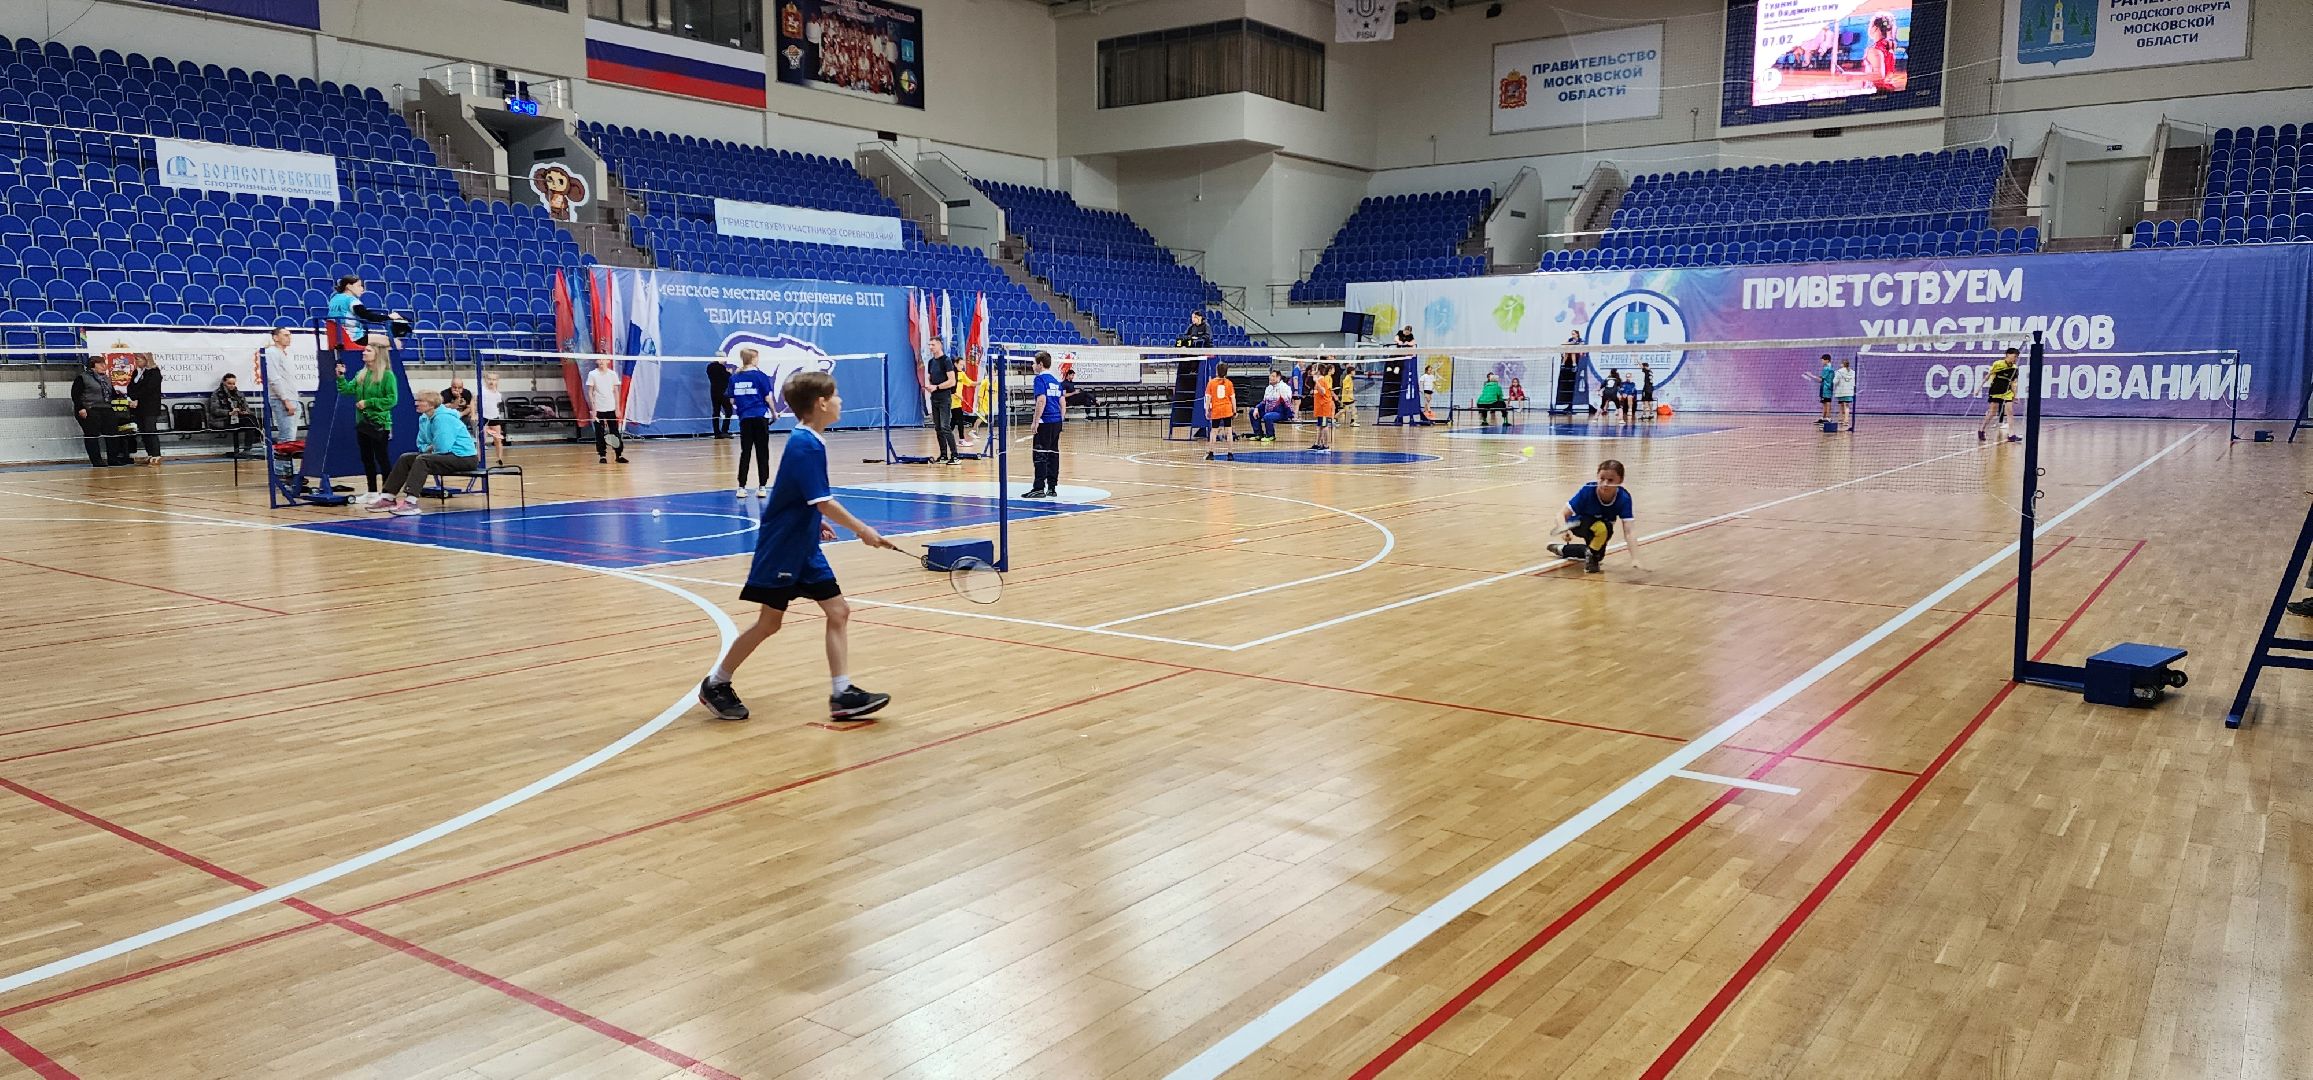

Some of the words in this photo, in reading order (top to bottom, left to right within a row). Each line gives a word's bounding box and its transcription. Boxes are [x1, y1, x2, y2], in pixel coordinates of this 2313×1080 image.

[2110, 6, 2185, 22] ГОРОДСКОГО
[2187, 1, 2231, 14] ОКРУГА
[2123, 15, 2215, 35] МОСКОВСКОЙ
[1762, 35, 1794, 47] 07.02
[2136, 33, 2199, 48] ОБЛАСТИ
[1532, 49, 1657, 75] ПРАВИТЕЛЬСТВО
[1543, 65, 1643, 89] МОСКОВСКОЙ
[1558, 85, 1627, 102] ОБЛАСТИ
[204, 180, 277, 193] спортивный
[281, 186, 333, 197] комплекс
[722, 216, 787, 231] ПРИВЕТСТВУЕМ
[788, 222, 837, 236] УЧАСТНИКОВ
[722, 287, 781, 301] местное
[783, 289, 853, 305] отделение
[855, 291, 885, 308] ВПП
[1742, 267, 2023, 310] ПРИВЕТСТВУЕМ
[704, 307, 773, 324] "ЕДИНАЯ
[775, 311, 836, 327] РОССИЯ"
[1859, 314, 2115, 352] УЧАСТНИКОВ
[154, 353, 225, 362] РАВИТЕЛЬСТВО
[160, 362, 214, 372] СКОВСКОЙ
[162, 373, 193, 382] ЛАСТИ
[1925, 358, 2252, 401] СОРНОВАНИЙ!
